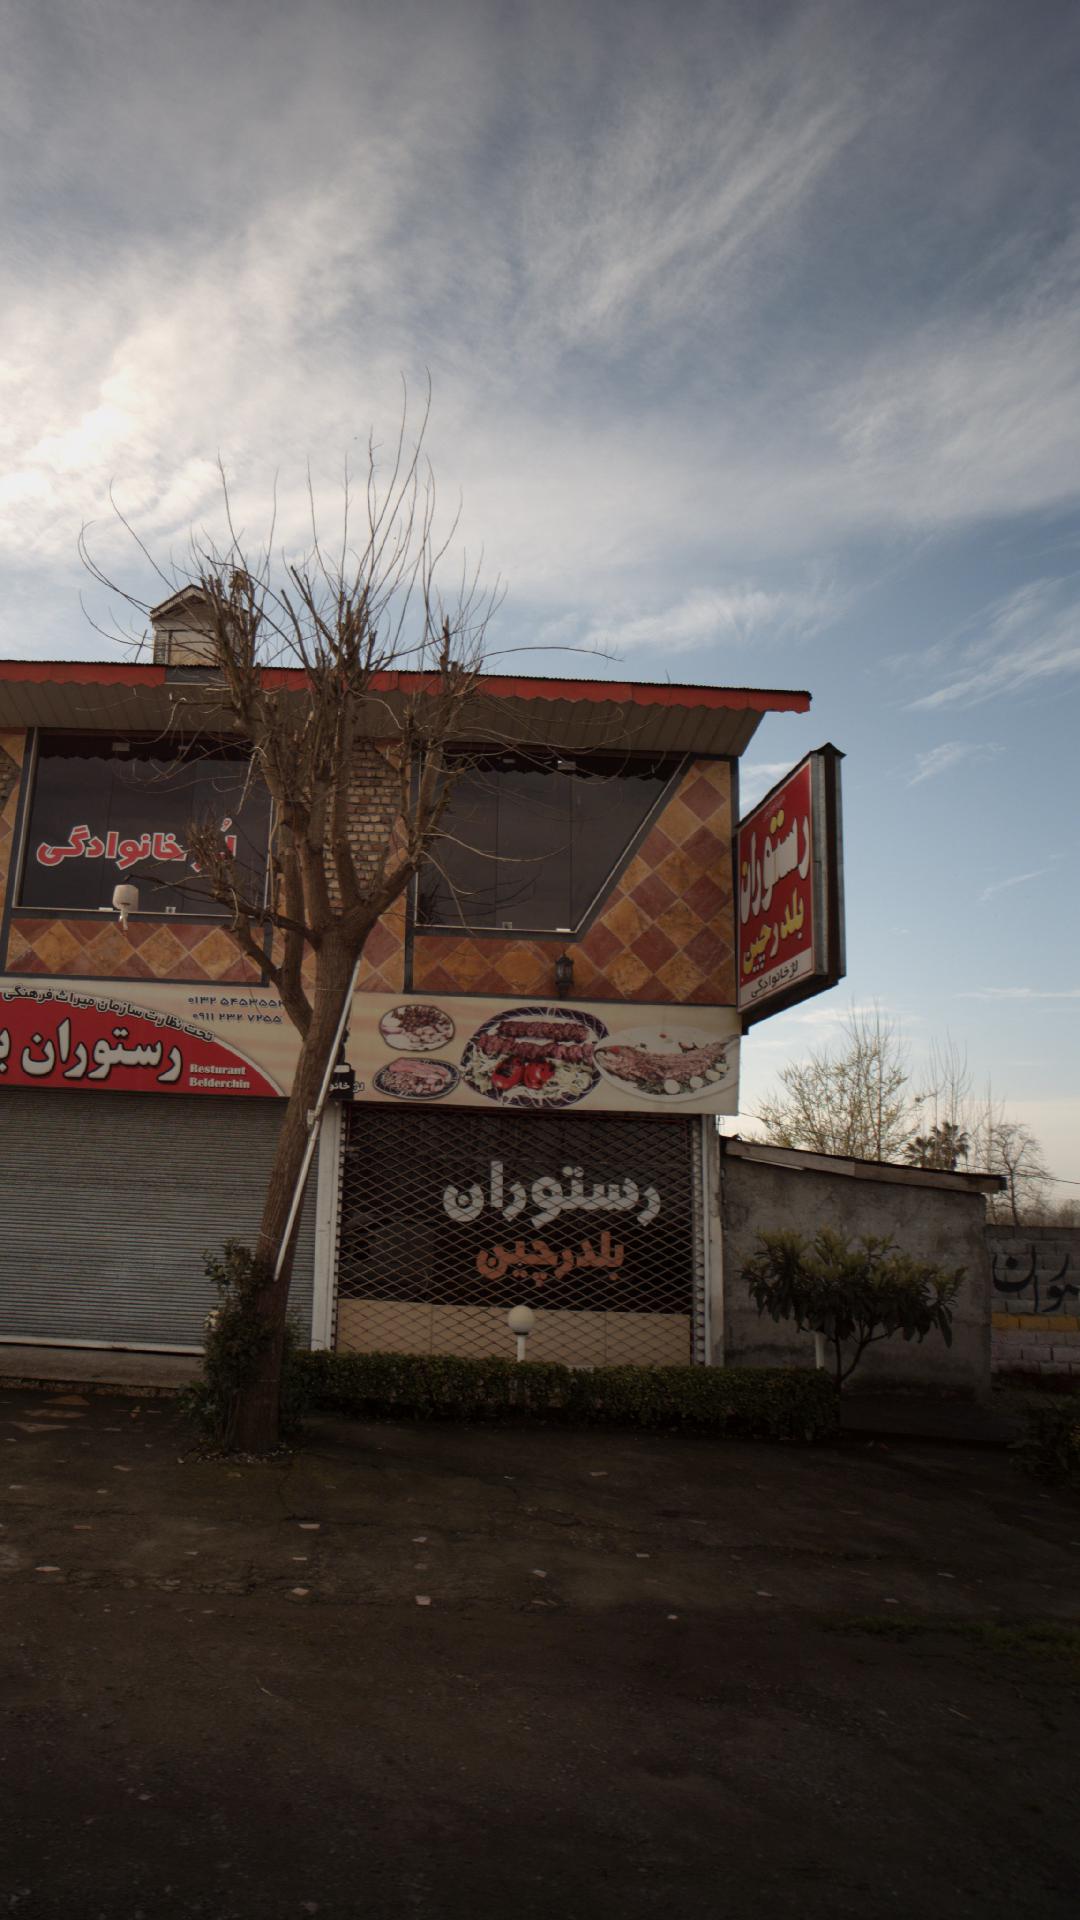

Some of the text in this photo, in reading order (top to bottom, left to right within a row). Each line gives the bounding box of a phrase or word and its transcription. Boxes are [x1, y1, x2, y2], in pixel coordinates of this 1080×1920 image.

[36, 824, 188, 870] خانوادگی
[740, 809, 810, 925] رستوران
[742, 888, 806, 976] بلدرچین
[750, 967, 790, 998] خانوادگی
[3, 984, 213, 1042] تحت نظارت سازمان میراث فرهنگی
[21, 1016, 183, 1082] رستوران
[189, 1063, 247, 1076] Resturant
[188, 1076, 251, 1089] Belderchin
[443, 1160, 661, 1229] رستوران
[475, 1231, 625, 1287] بلدرچین
